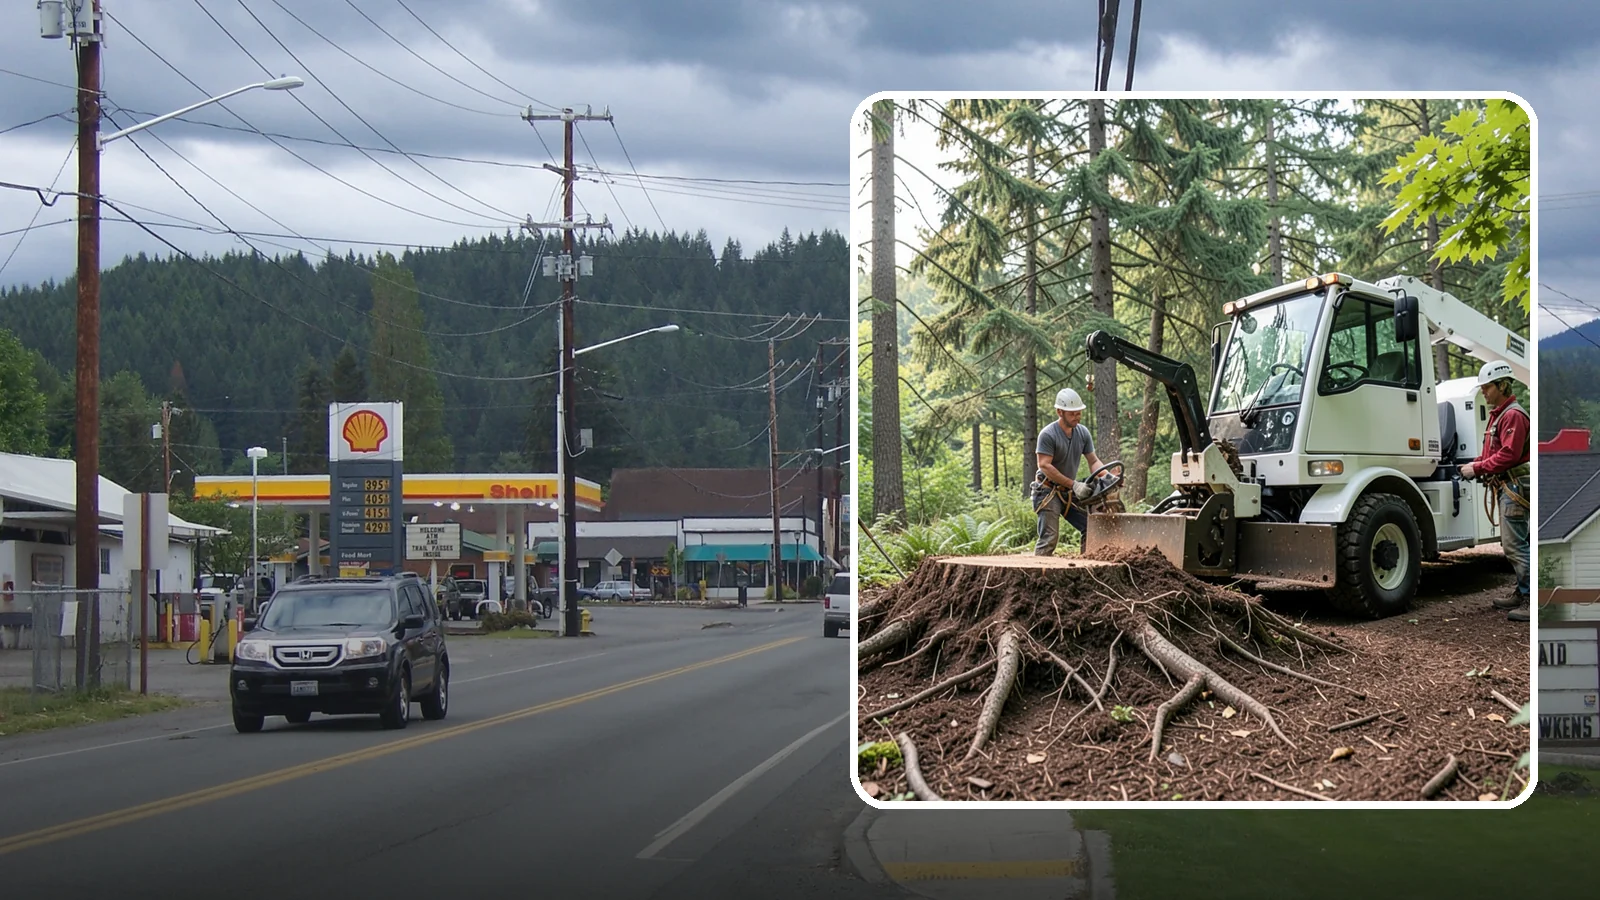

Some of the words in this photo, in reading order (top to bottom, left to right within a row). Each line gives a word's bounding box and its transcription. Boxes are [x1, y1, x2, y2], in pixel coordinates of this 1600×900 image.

[365, 480, 384, 490] 395
[489, 484, 548, 499] Shell
[365, 494, 384, 504] 405
[365, 508, 383, 518] 415
[365, 522, 384, 532] 429
[1538, 643, 1567, 665] AID
